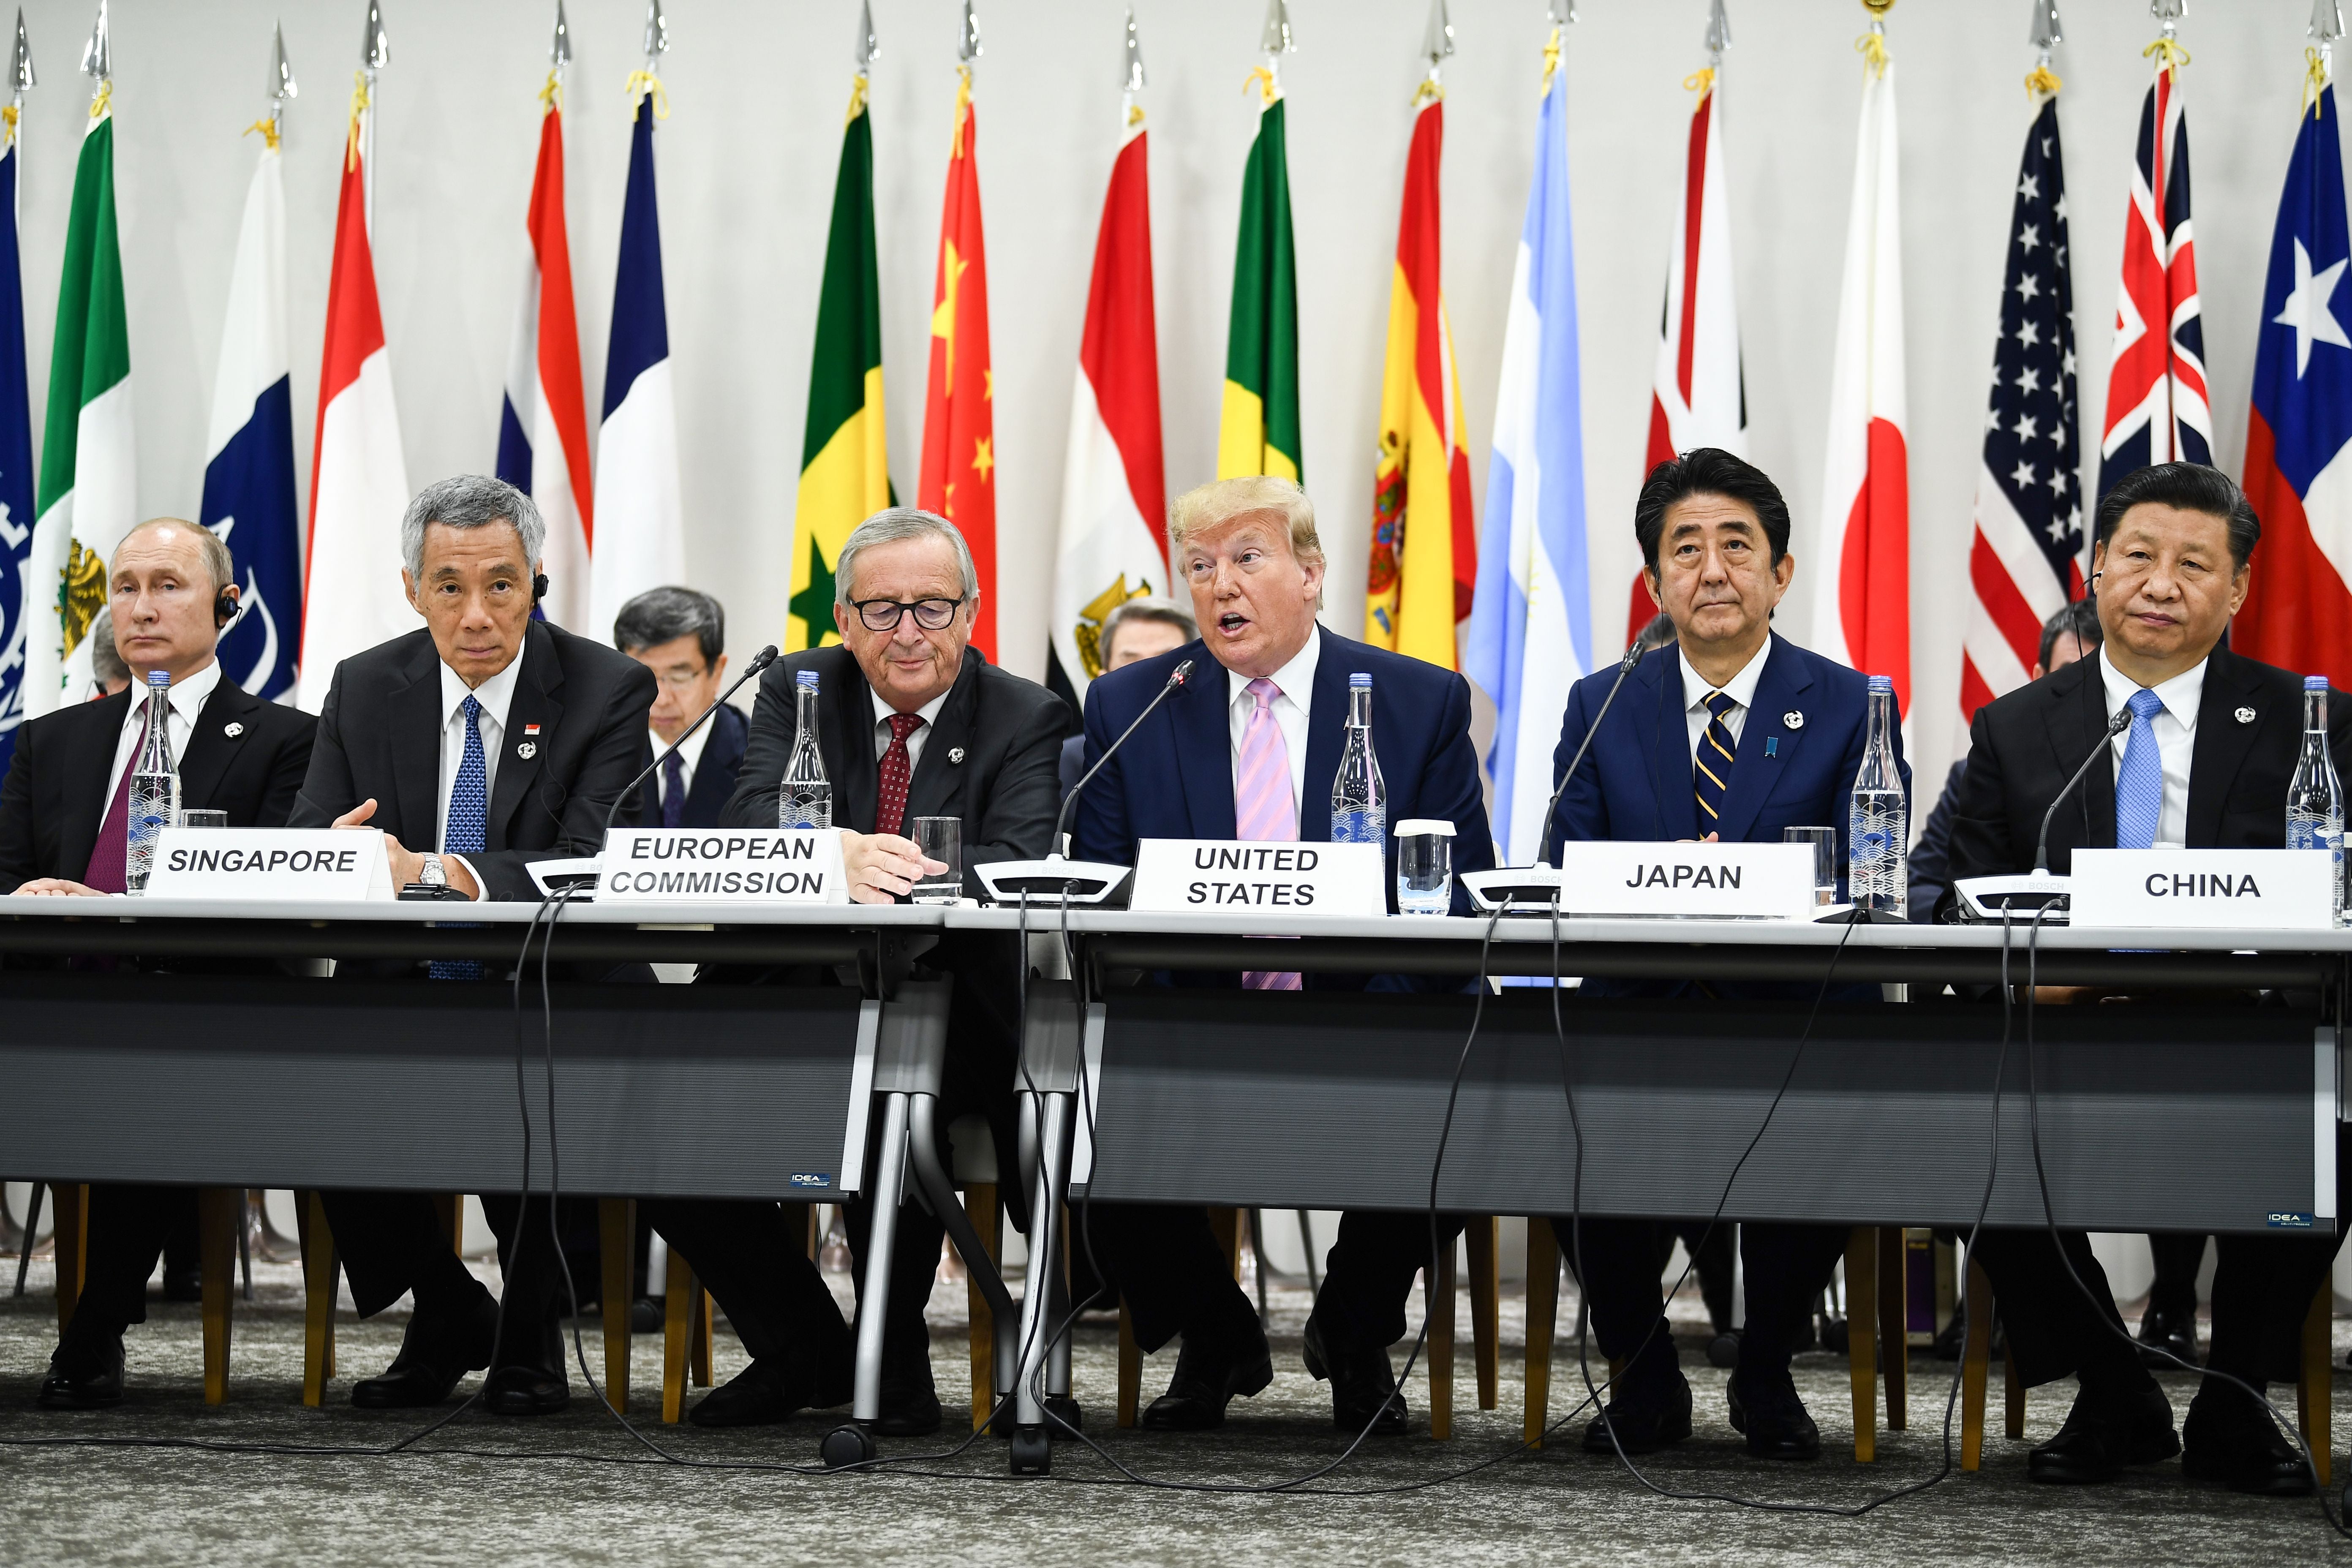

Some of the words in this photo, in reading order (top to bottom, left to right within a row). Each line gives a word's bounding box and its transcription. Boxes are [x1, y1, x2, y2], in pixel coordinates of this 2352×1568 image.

[632, 838, 814, 859] EUROPEAN
[1195, 848, 1318, 871] UNITED
[169, 850, 357, 871] SINGAPORE
[611, 872, 823, 893] COMMISSION
[1626, 865, 1741, 889] JAPAN
[2145, 874, 2261, 897] CHINA
[1187, 882, 1314, 905] STATES
